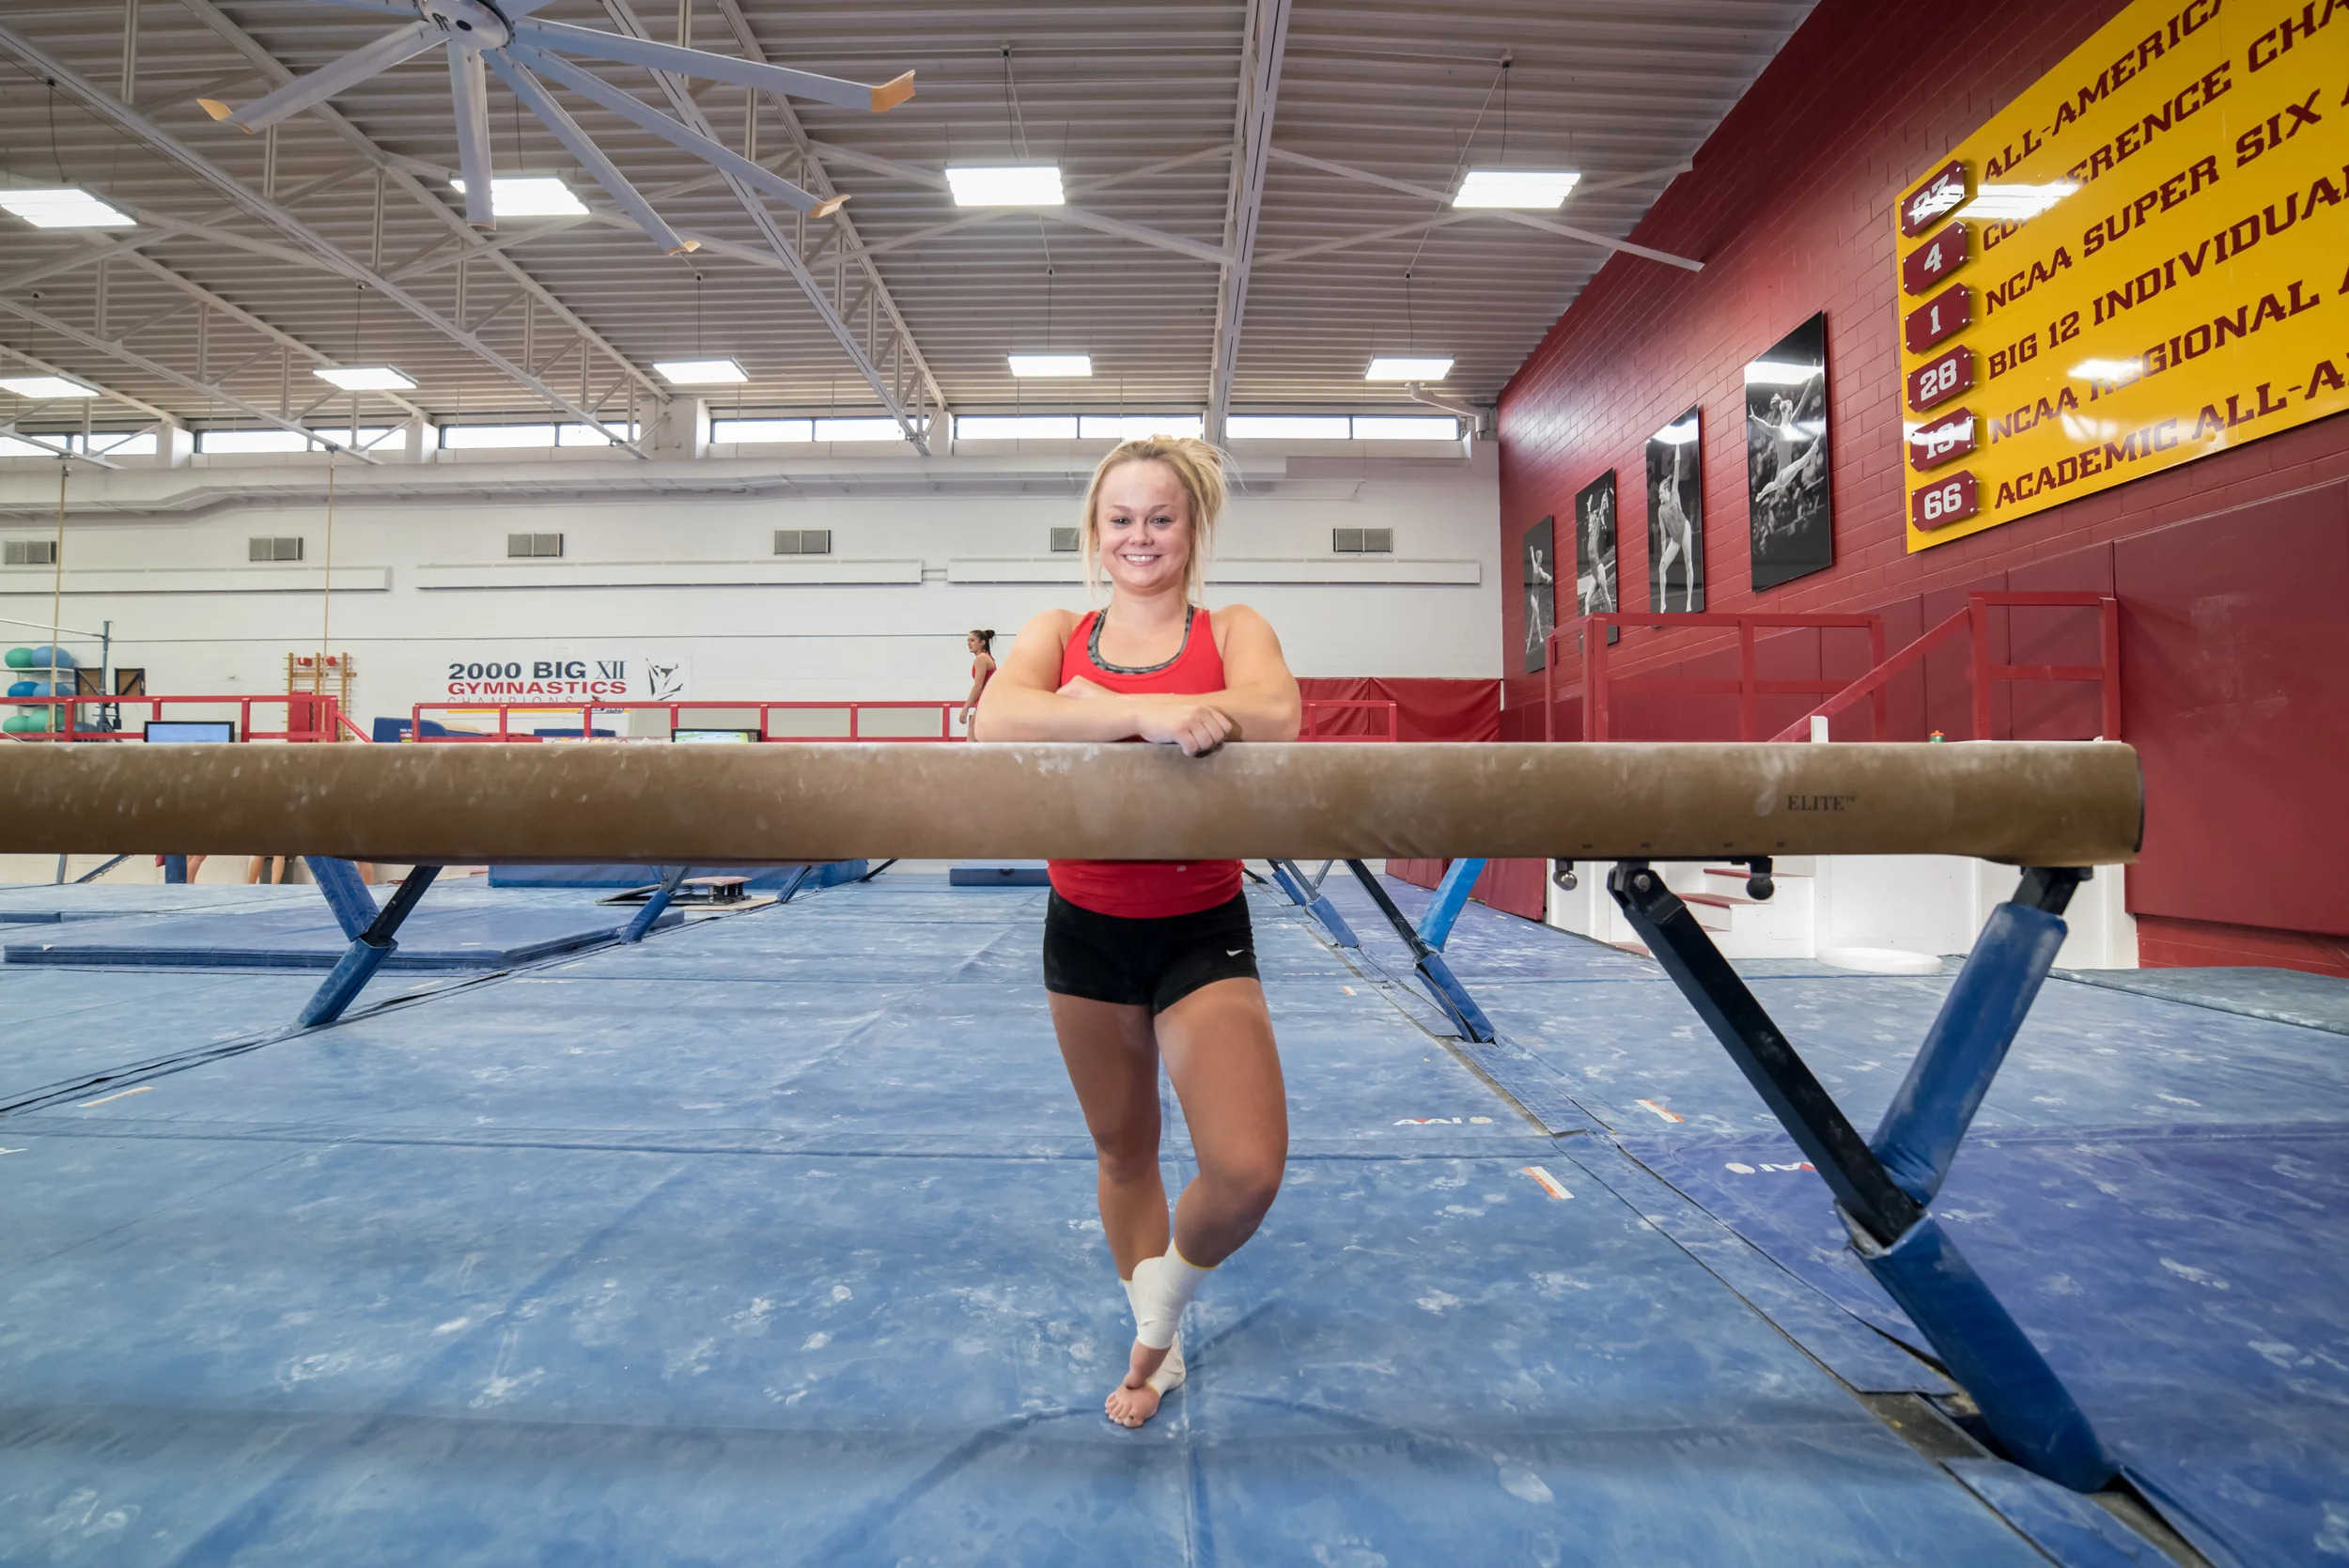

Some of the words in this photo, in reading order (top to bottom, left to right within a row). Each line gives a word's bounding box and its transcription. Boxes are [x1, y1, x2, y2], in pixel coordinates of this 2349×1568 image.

[1929, 305, 1941, 335] 1
[1985, 245, 2073, 316] NCAA
[2083, 154, 2219, 258] SUPER
[2235, 87, 2322, 169] SIX
[1920, 358, 1957, 401] 28
[1988, 332, 2037, 380] BIG
[2048, 310, 2080, 349] 12
[2092, 163, 2349, 327] INDIVIDUA
[1923, 242, 1942, 272] 4
[1923, 482, 1962, 520] 66
[1994, 417, 2178, 510] ACADEMIC
[2191, 351, 2349, 441] ALL-A
[1991, 385, 2078, 444] NCAA
[447, 661, 522, 680] 2000
[533, 660, 586, 679] BIG
[595, 660, 628, 680] XII
[447, 680, 628, 695] GYMNASTICS
